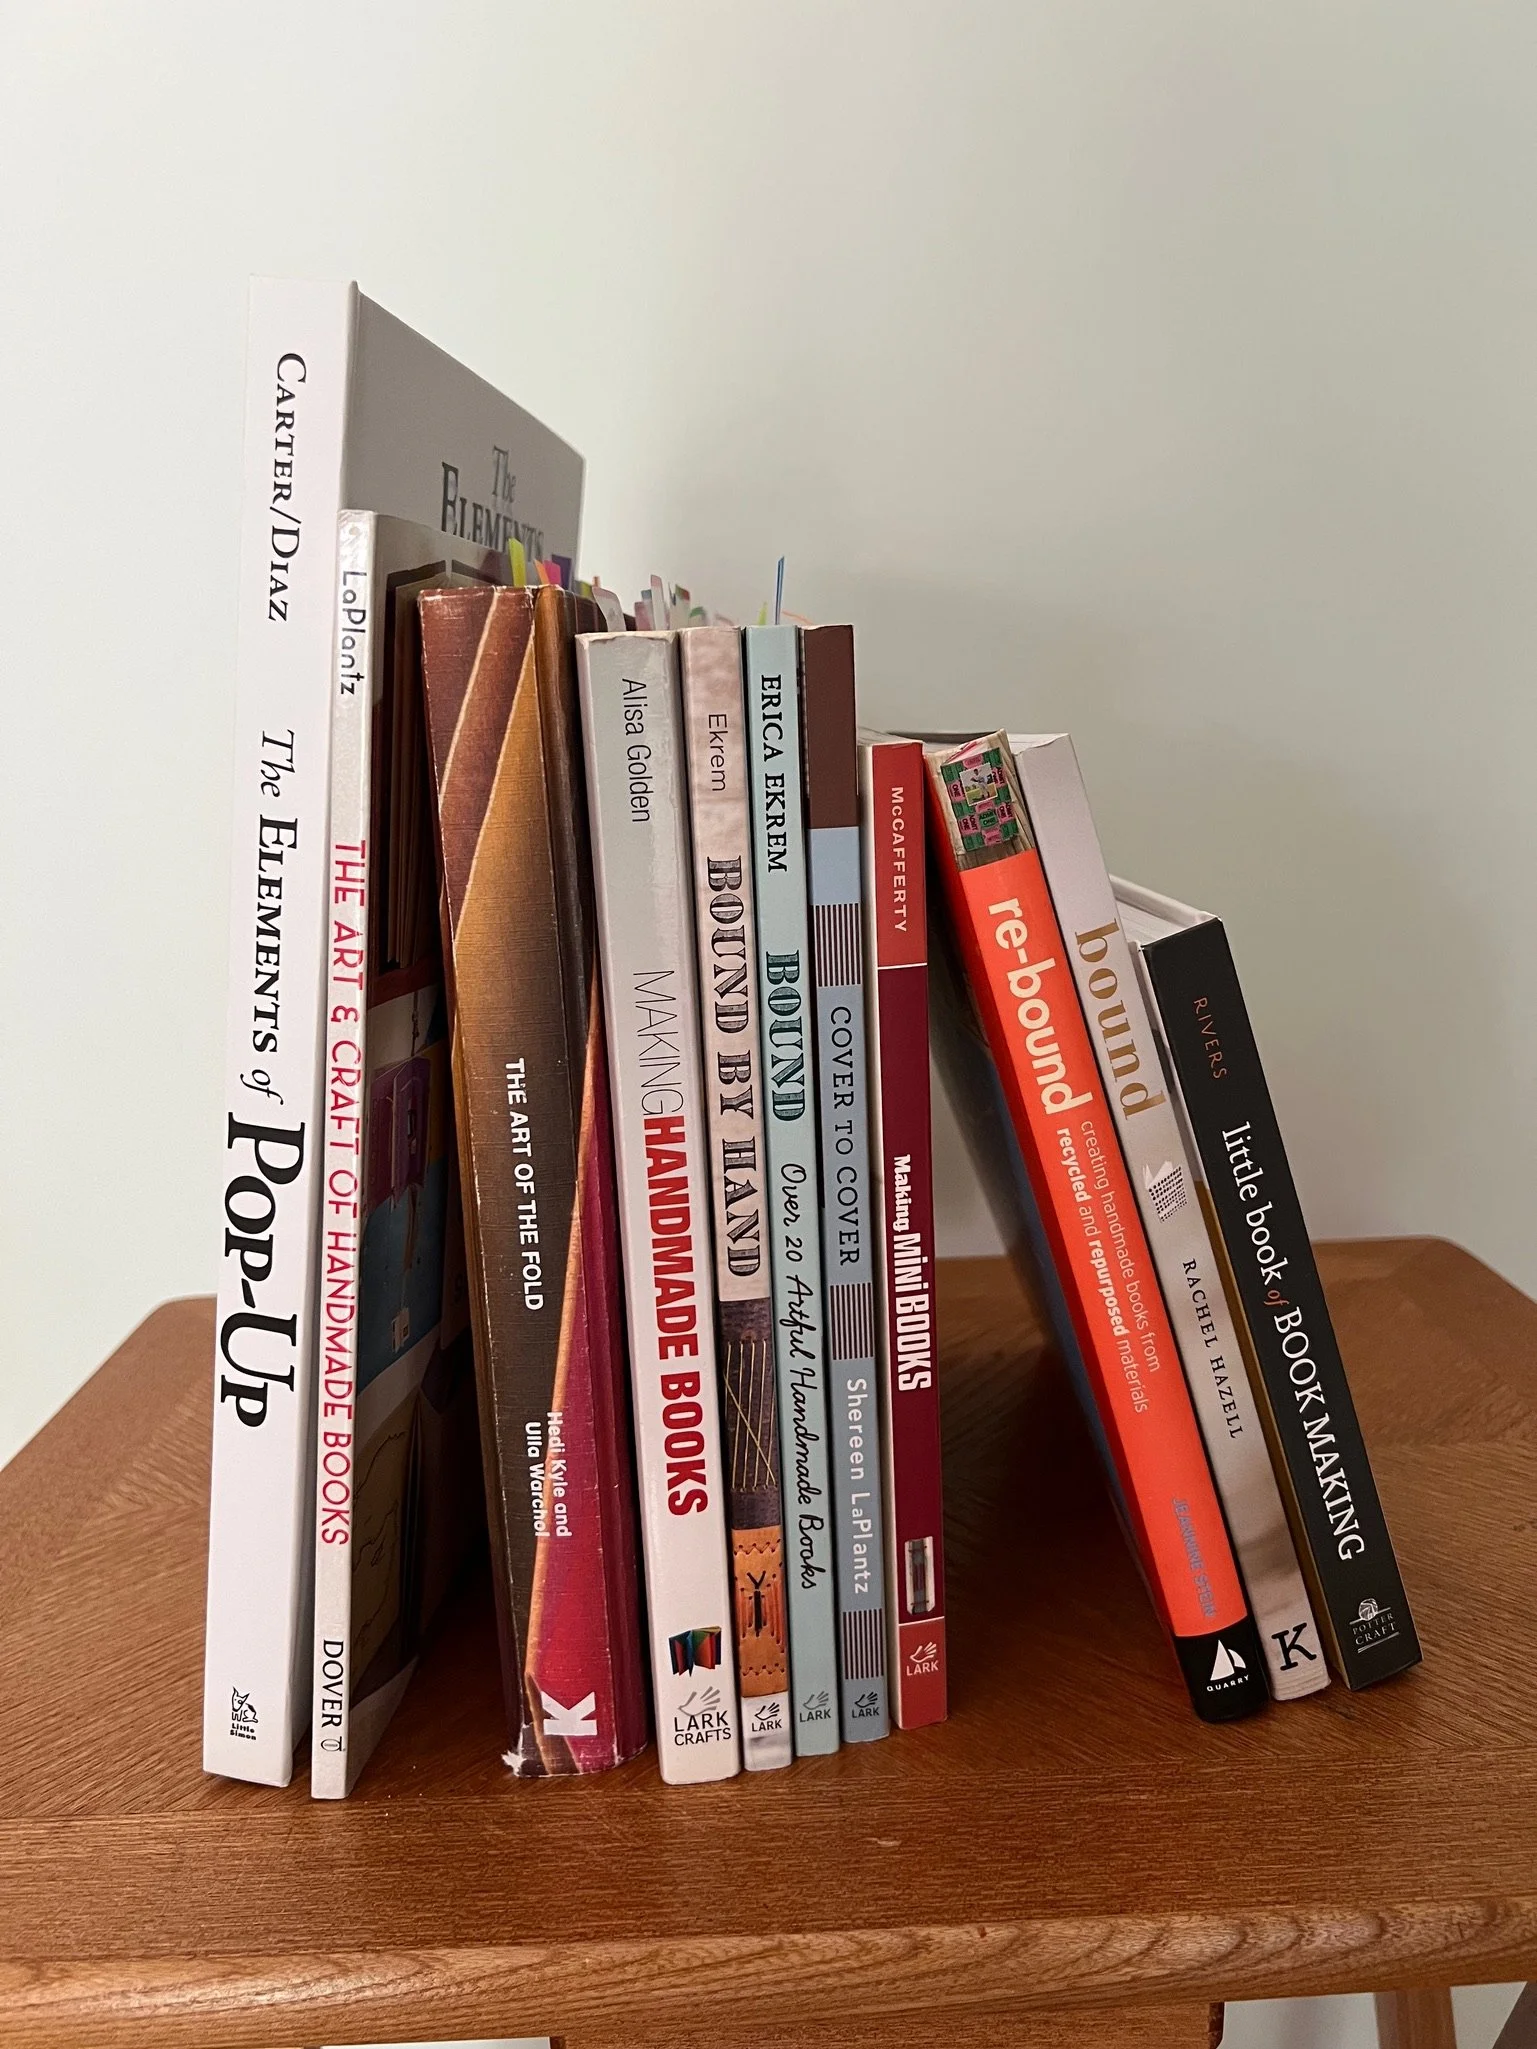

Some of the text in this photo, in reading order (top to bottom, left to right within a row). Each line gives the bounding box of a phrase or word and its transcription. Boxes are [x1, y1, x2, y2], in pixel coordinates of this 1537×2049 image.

[492, 445, 516, 503] The
[261, 729, 296, 797] The
[622, 678, 652, 822] Alisa Golden
[708, 714, 728, 791] Ekrem
[760, 674, 788, 873] ERICA EKREM
[766, 949, 806, 1121] BOUND
[988, 898, 1093, 1114] re-bound
[1075, 918, 1166, 1120] bound
[1194, 997, 1227, 1079] RIVERS
[240, 1068, 284, 1105] of
[707, 856, 760, 1277] BOUND BY HAND
[830, 1006, 860, 1266] COVER TO COVER
[1222, 1120, 1264, 1201] little
[321, 840, 366, 1545] THE ART & CRAFT OF HANDMADE BOOKS
[505, 1058, 544, 1311] THE ART OF THE FOLD
[892, 1154, 912, 1231] Making
[1057, 1128, 1148, 1413] recycled and repurposed materials
[1081, 1120, 1160, 1372] creating handmade books from
[1246, 1201, 1288, 1286] book
[1263, 1289, 1289, 1306] of
[778, 1163, 826, 1590] Over 20 Artful Handmade Books
[895, 1294, 932, 1391] BOOKS
[1183, 1259, 1244, 1439] RACHEL HAZELL
[525, 1421, 550, 1537] Ulla Warchol
[547, 1411, 572, 1536] Hedi Kyle and
[660, 1370, 708, 1516] BOOKS
[847, 1378, 873, 1594] Shereen LaPlantz
[1272, 1623, 1316, 1671] K
[1352, 1613, 1394, 1635] POTTER
[1355, 1622, 1398, 1646] CRAFT
[320, 1640, 345, 1728] DOVER
[906, 1661, 939, 1676] LARK
[1206, 1675, 1250, 1692] QUARRY
[230, 1729, 257, 1740] Simon
[231, 1722, 255, 1734] Little
[674, 1710, 729, 1732] LARK
[674, 1728, 732, 1746] CRAFTS
[751, 1718, 782, 1732] LARK
[799, 1708, 832, 1724] LARK
[852, 1706, 880, 1718] LARK
